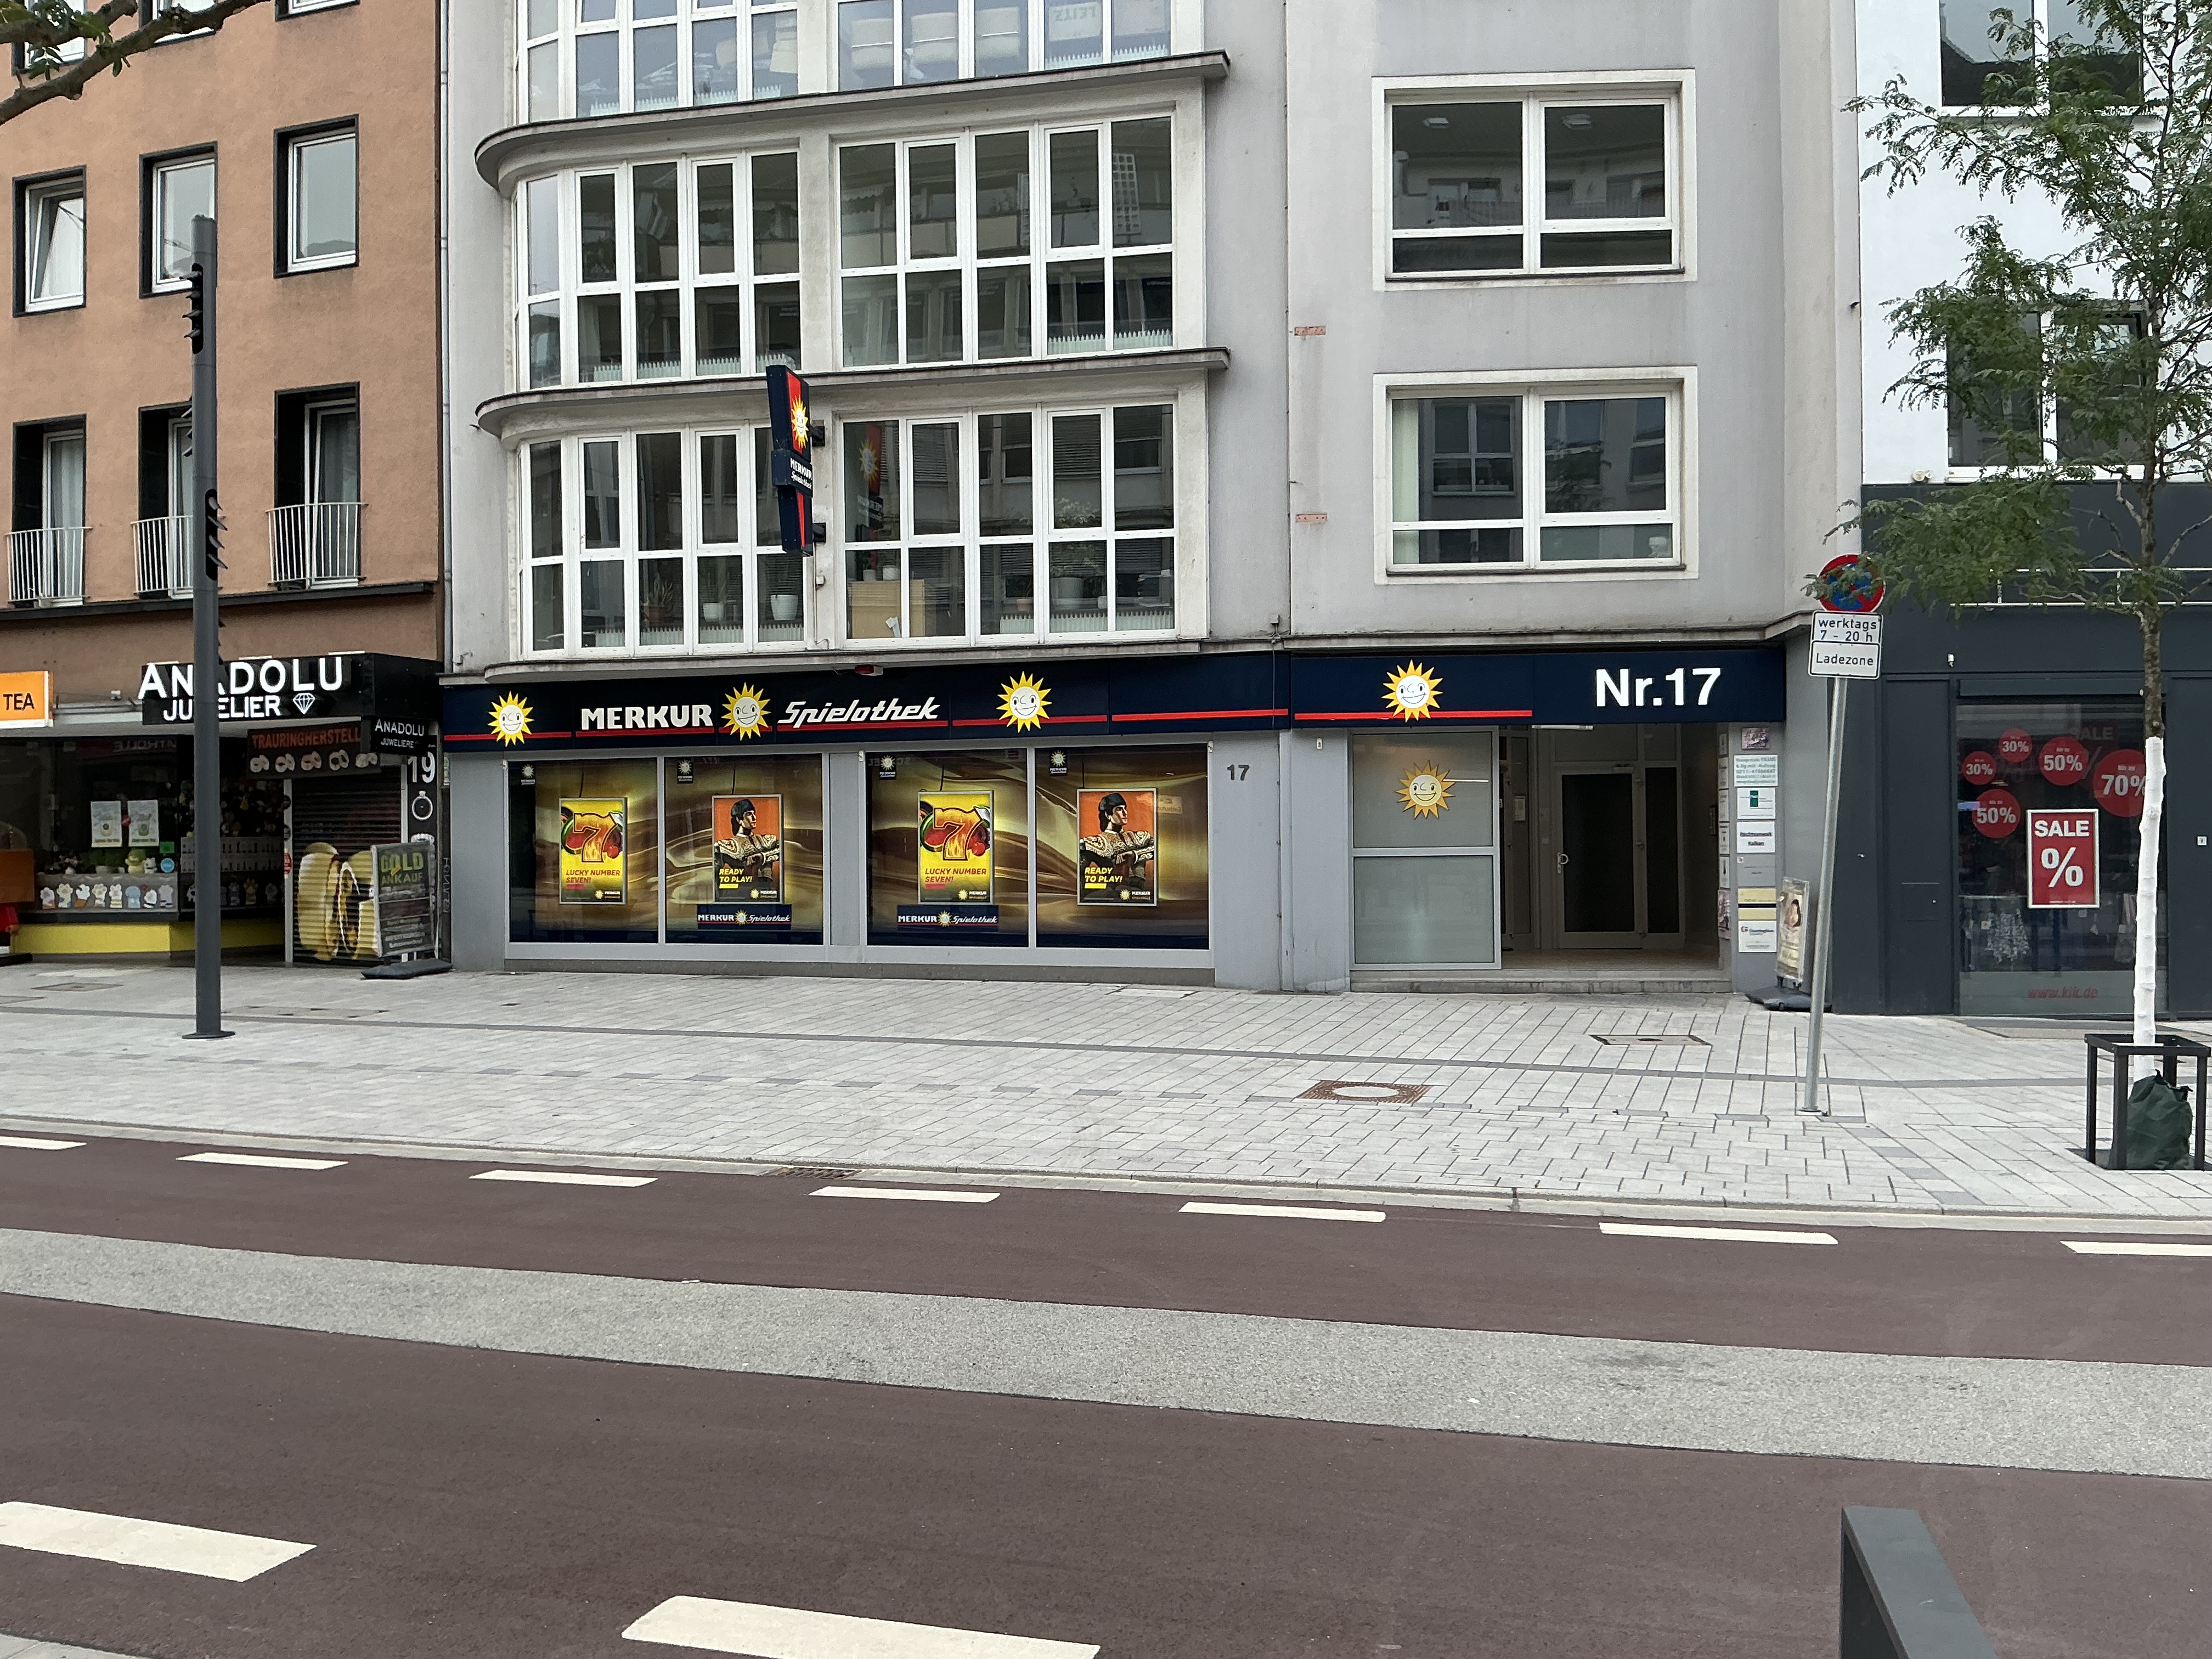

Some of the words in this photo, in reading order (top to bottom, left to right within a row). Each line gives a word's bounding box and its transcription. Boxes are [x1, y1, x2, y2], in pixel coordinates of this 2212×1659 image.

[790, 457, 812, 481] MERKUR
[1818, 618, 1877, 631] werktags
[1820, 630, 1827, 640] 7
[1845, 631, 1859, 641] 20
[1865, 632, 1872, 642] h
[1816, 653, 1874, 665] Ladezone
[138, 656, 343, 699] ANDOLU
[1596, 668, 1722, 707] Nr.17
[3, 692, 35, 710] TEA
[163, 695, 281, 721] JUELIER
[581, 704, 713, 730] MERKUR
[777, 697, 940, 729] Spielothek
[374, 718, 425, 736] ANADOLU
[2002, 741, 2029, 752] 30%
[407, 751, 435, 783] 19
[1966, 763, 1993, 775] 30%
[2044, 754, 2083, 771] 50%
[1227, 764, 1250, 781] 17
[2101, 775, 2147, 797] 70%
[1977, 806, 2017, 823] 50%
[573, 811, 617, 863] 7
[933, 805, 983, 861] 7
[2034, 820, 2090, 837] SALE
[380, 852, 424, 873] GOLD
[2041, 847, 2084, 888] %
[381, 872, 424, 885] ANKAUF
[747, 915, 791, 923] Spielothek
[952, 916, 998, 924] Spielothek
